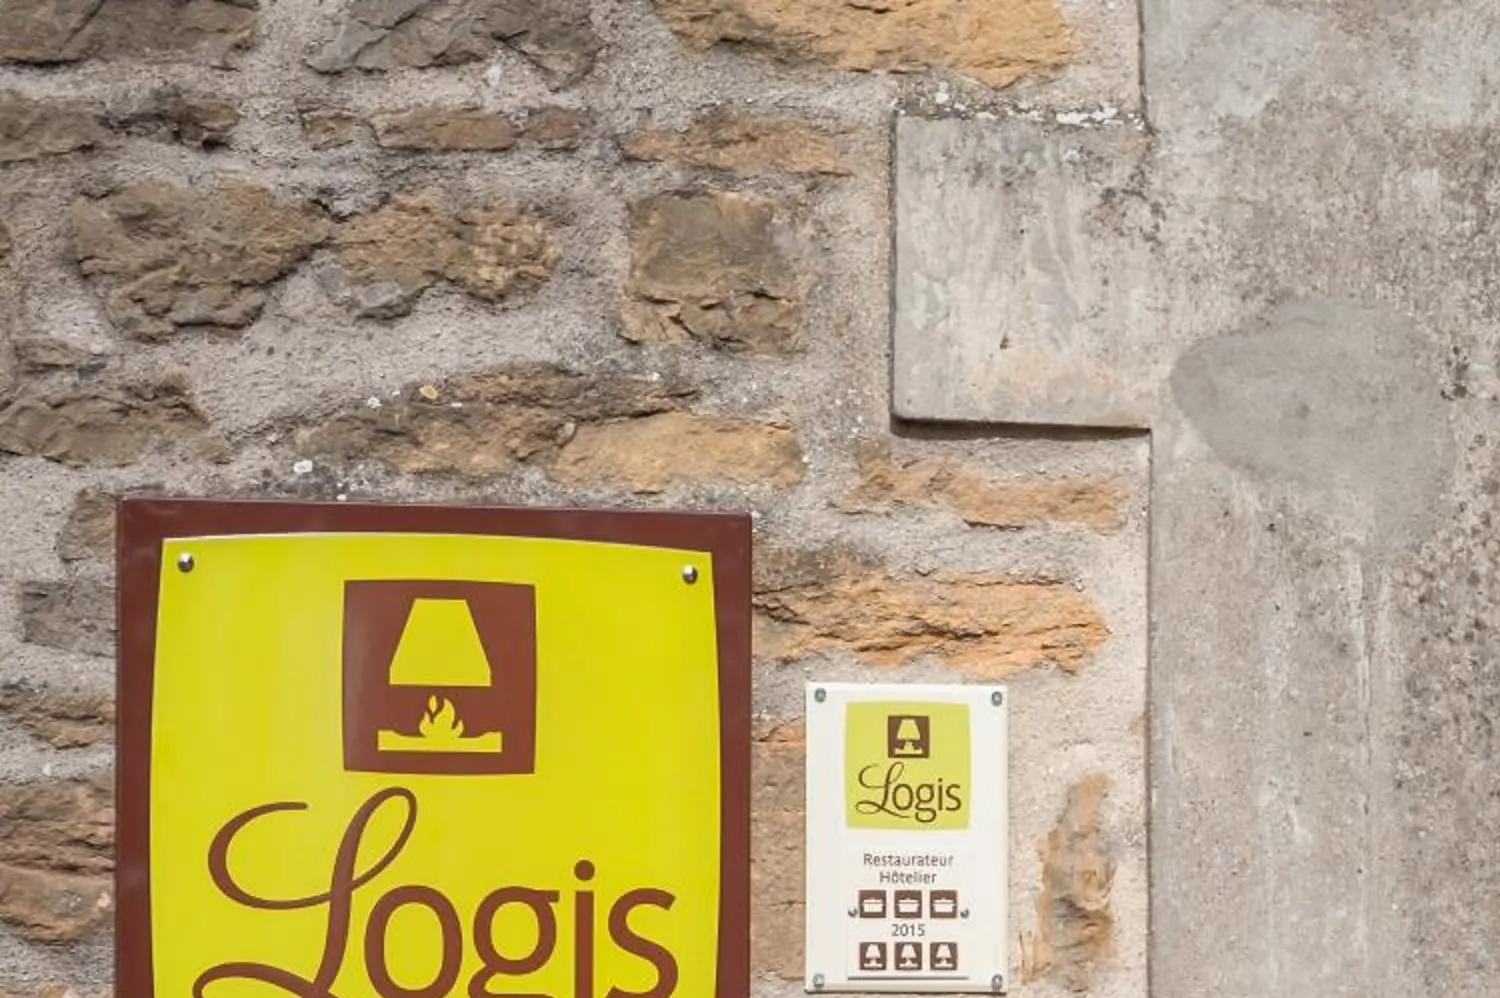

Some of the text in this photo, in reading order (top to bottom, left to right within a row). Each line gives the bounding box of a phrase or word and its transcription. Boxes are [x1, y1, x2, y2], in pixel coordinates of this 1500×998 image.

[855, 761, 962, 824] Logis
[863, 852, 955, 867] Restaurateur
[879, 870, 937, 884] Hôtelier
[891, 923, 926, 937] 2015
